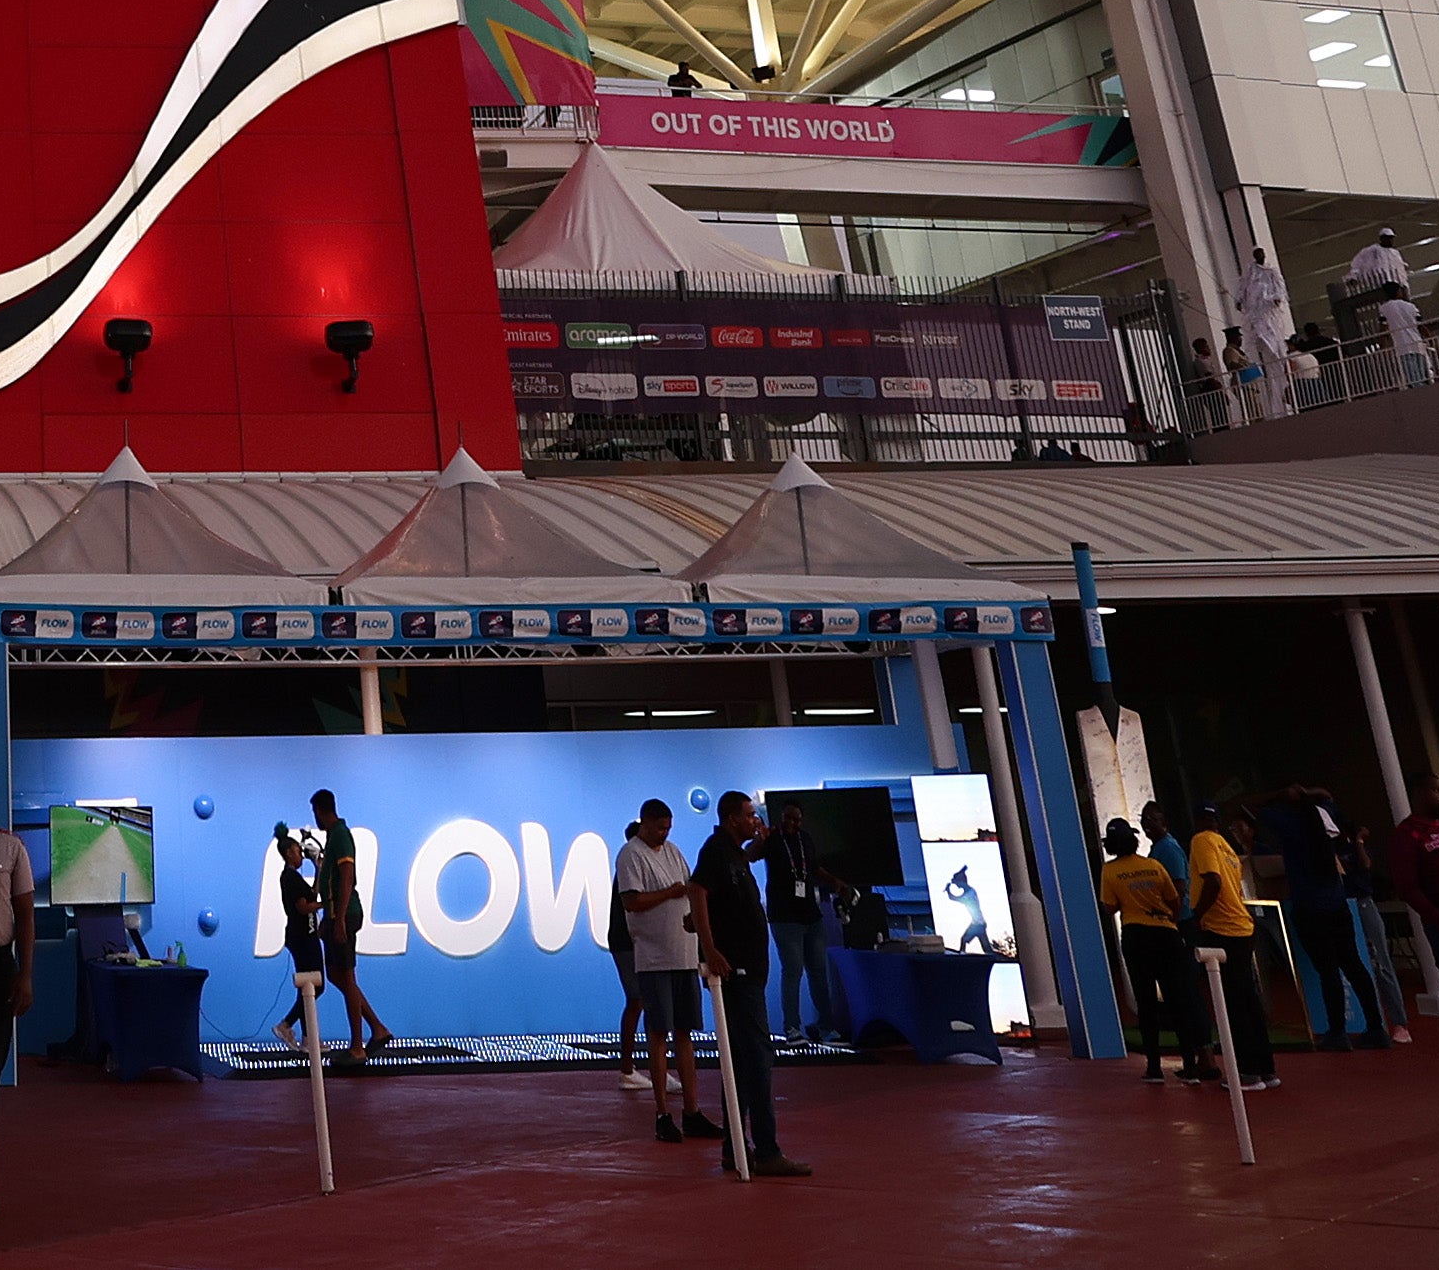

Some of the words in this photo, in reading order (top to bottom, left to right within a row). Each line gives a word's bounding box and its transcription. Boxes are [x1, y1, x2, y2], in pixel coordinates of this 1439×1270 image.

[651, 111, 702, 135] OUT
[709, 114, 743, 135] OF
[746, 116, 802, 139] THIS
[804, 119, 895, 142] WORLD
[1047, 306, 1101, 317] NORTH-WEST
[1063, 319, 1091, 330] STAND
[777, 329, 813, 338] IndusInd
[791, 338, 812, 347] Bank
[524, 376, 547, 385] STAR
[524, 384, 559, 394] SPORTS
[647, 382, 662, 392] sky
[664, 381, 696, 392] sports
[781, 382, 815, 390] WILLOW
[1009, 383, 1033, 397] sky
[1056, 384, 1100, 398] ESPN
[41, 619, 69, 628] FLOW
[518, 618, 545, 627] FLOW
[597, 617, 622, 627] FLOW
[674, 616, 700, 626] FLOW
[752, 616, 778, 626] FLOW
[828, 617, 855, 626] FLOW
[906, 615, 931, 624] FLOW
[983, 615, 1008, 624] FLOW
[122, 620, 150, 629] FLOW
[203, 620, 229, 629] FLOW
[282, 620, 309, 629] FLOW
[361, 620, 388, 629] FLOW
[441, 620, 466, 629] FLOW
